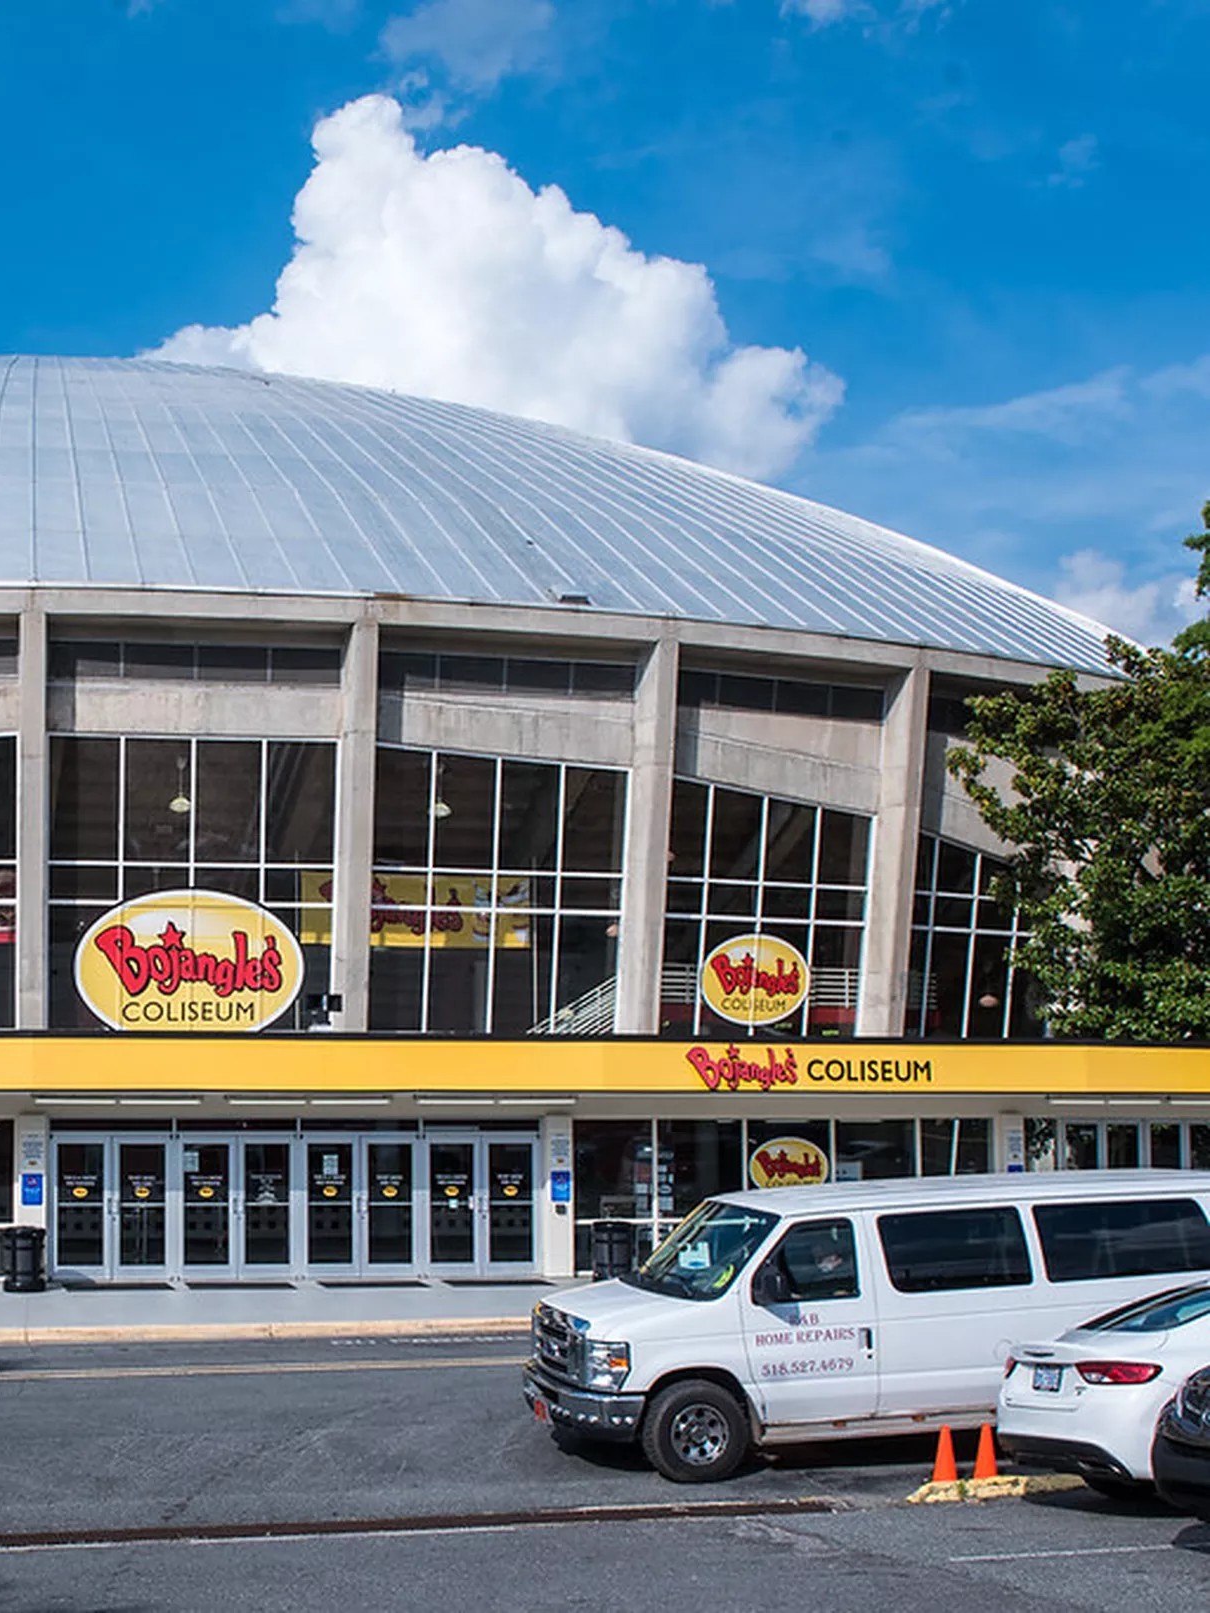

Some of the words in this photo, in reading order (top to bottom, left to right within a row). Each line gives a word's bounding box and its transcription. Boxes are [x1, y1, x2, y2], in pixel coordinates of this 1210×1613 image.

[122, 1001, 255, 1022] COLISEUM
[807, 1059, 932, 1082] COLISEUM
[755, 1332, 794, 1347] HOME
[796, 1327, 856, 1343] REPAIRS
